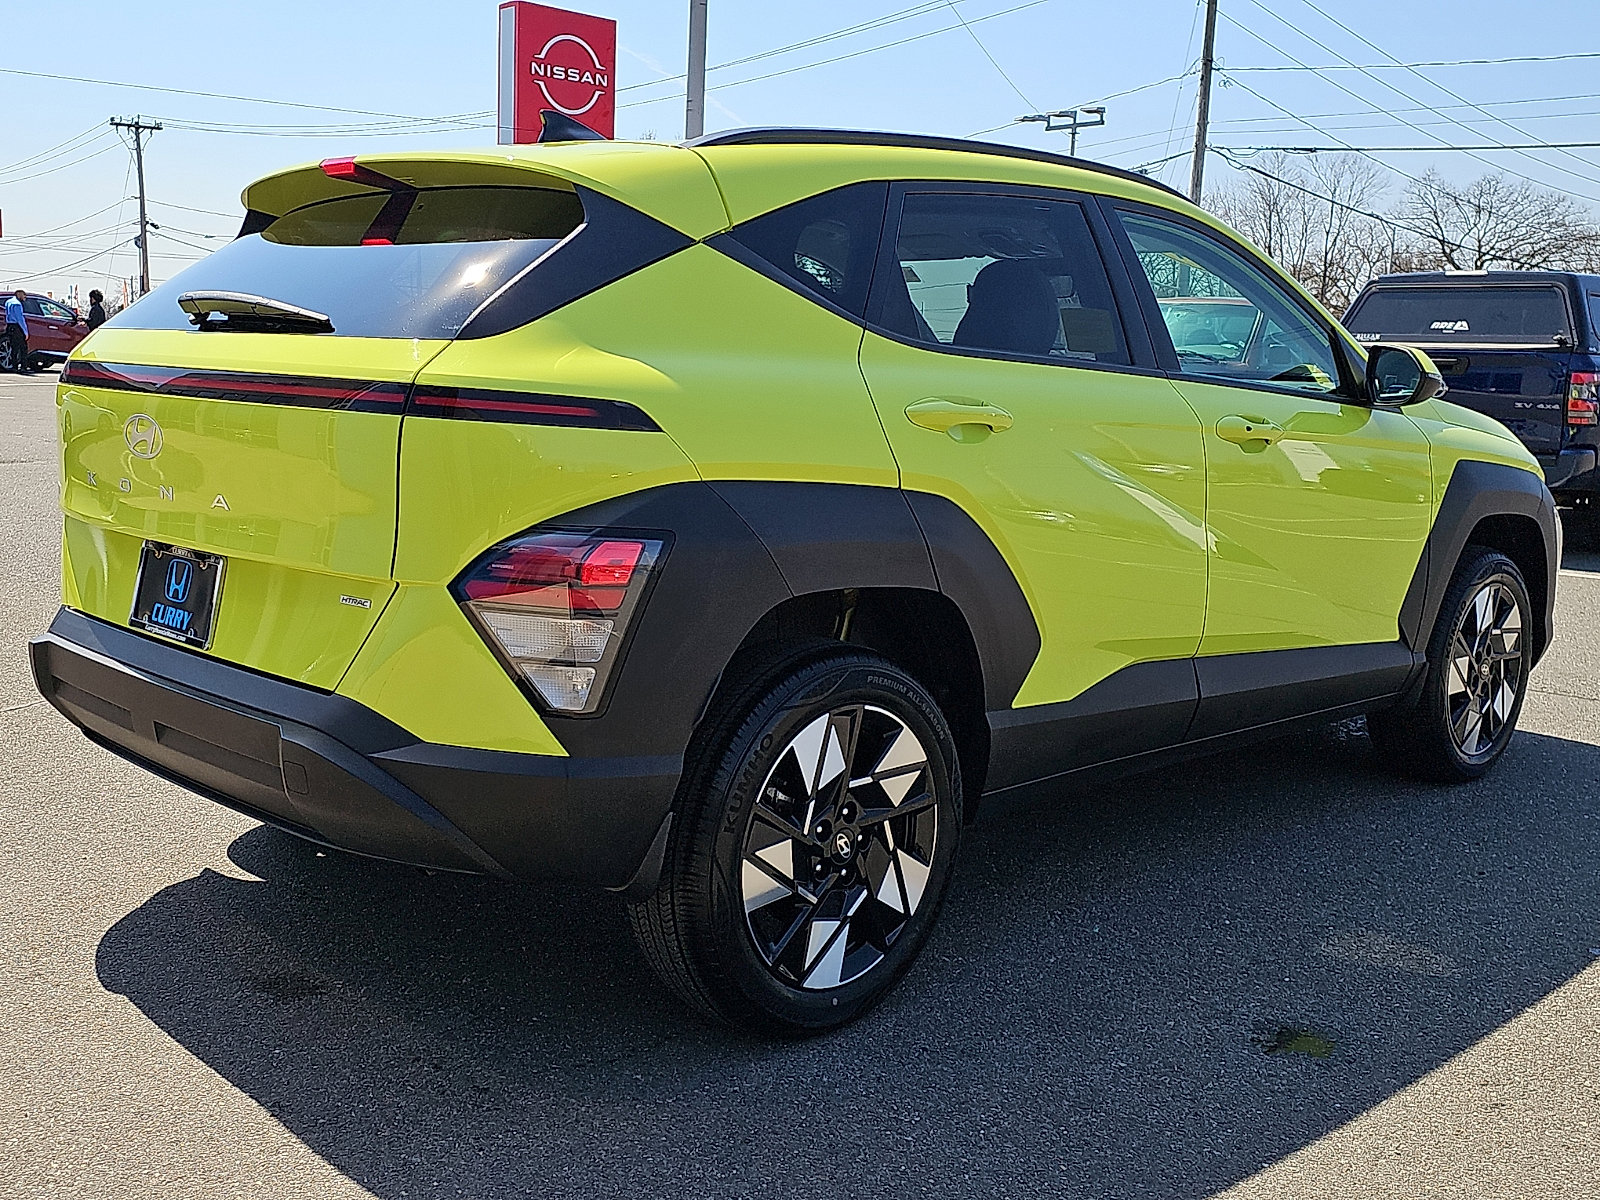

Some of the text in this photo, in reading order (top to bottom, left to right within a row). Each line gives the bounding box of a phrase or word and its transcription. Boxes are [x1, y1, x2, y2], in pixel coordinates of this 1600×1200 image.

[531, 62, 608, 87] NISSAN
[86, 470, 230, 511] KONA
[341, 597, 369, 607] HTRAC
[152, 603, 193, 630] CURRY
[866, 675, 907, 695] PREMIUM
[723, 733, 774, 834] KUMHO
